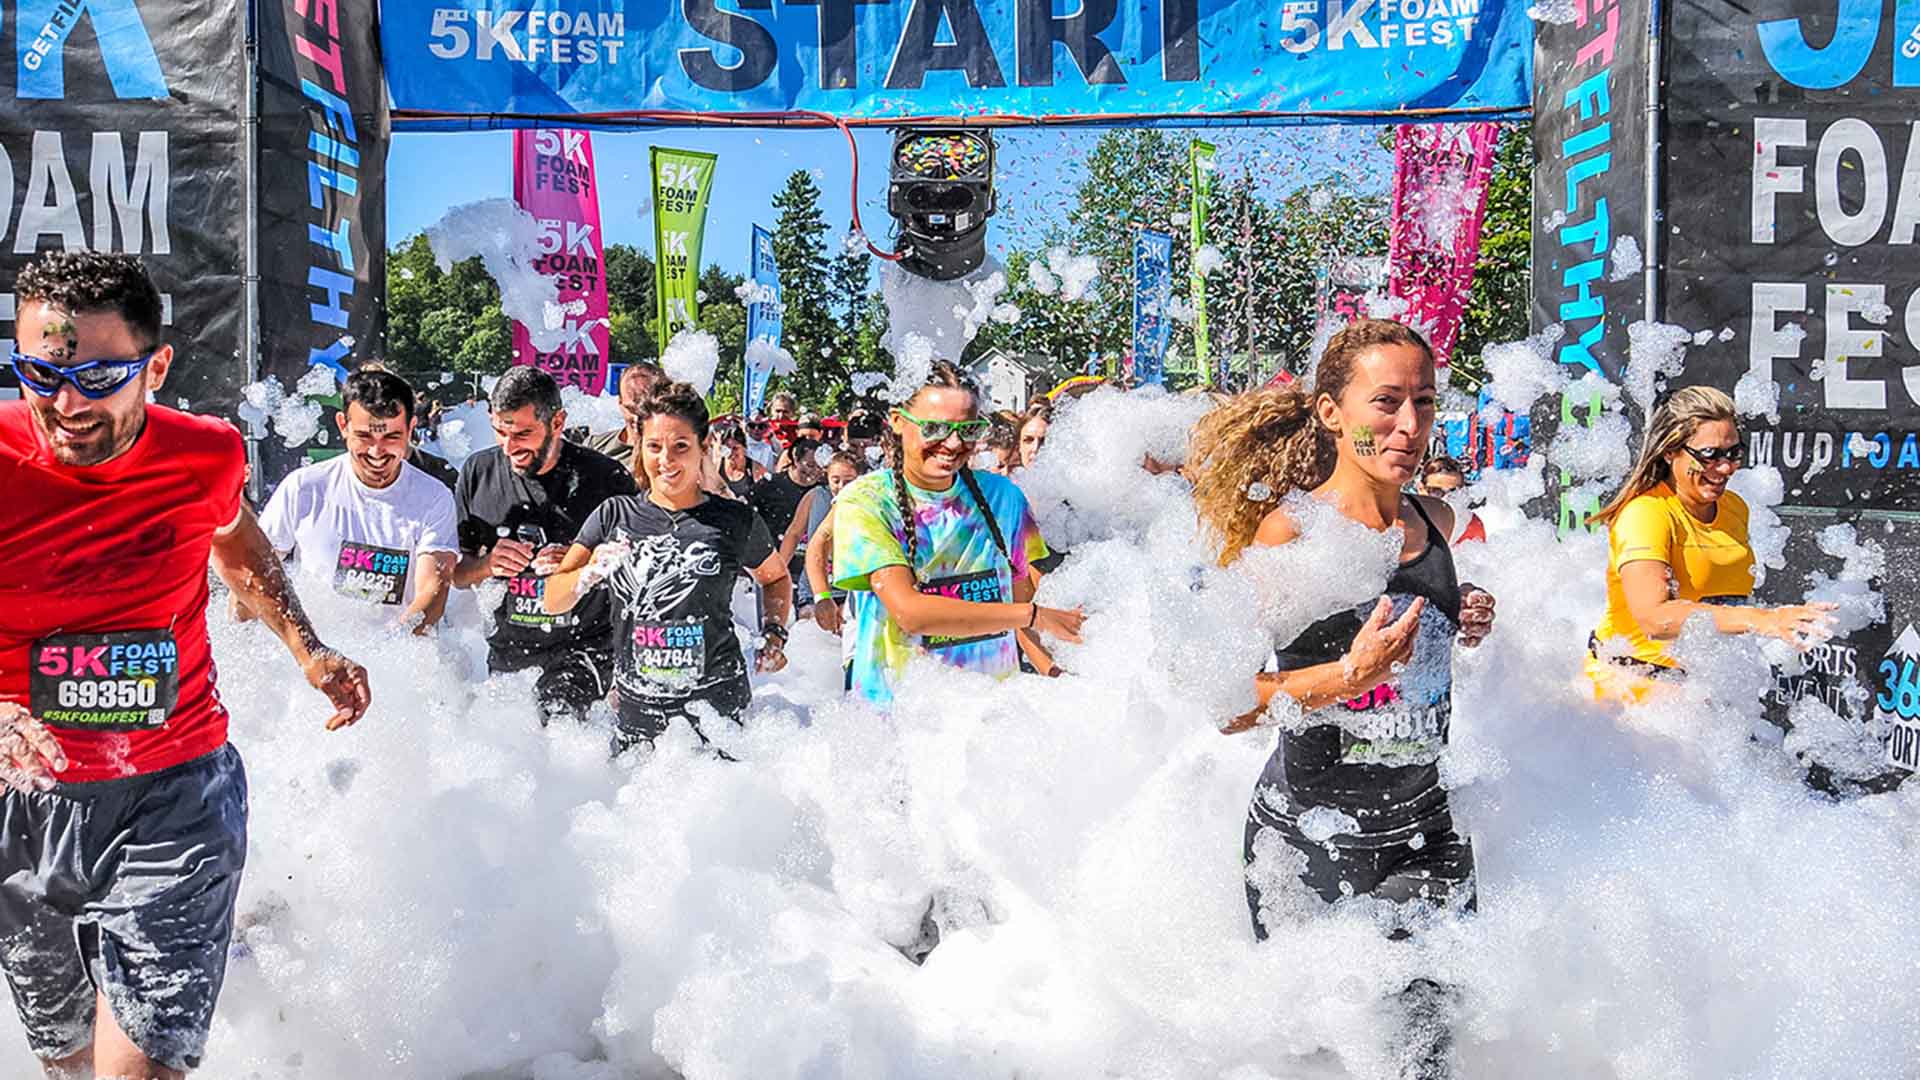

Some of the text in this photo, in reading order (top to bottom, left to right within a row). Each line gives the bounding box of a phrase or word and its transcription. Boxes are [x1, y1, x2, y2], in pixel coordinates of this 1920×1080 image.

[1379, 0, 1480, 21] FOAM
[428, 9, 527, 60] 5K
[528, 11, 625, 36] FOAM
[1280, 0, 1380, 53] 5K
[1380, 17, 1479, 49] FEST
[528, 38, 624, 64] FEST
[535, 128, 589, 167] 5K
[536, 154, 590, 182] FOAM
[661, 162, 701, 190] 5K
[536, 172, 590, 198] FEST
[660, 186, 698, 203] FOAM
[536, 219, 598, 258] 5K
[553, 272, 598, 291] EST
[340, 547, 376, 571] 5K
[374, 561, 407, 576] FEST
[375, 552, 409, 566] FOAM
[509, 576, 538, 597] 5K
[962, 577, 998, 592] FOAM
[635, 626, 667, 648] 5K
[667, 626, 704, 637] FOAM
[667, 636, 704, 648] FEST
[38, 645, 110, 677] 5K
[111, 640, 177, 661] FOAM
[111, 657, 177, 677] FEST
[58, 679, 156, 709] 69350
[42, 709, 148, 724] #5KFOAMFEST
